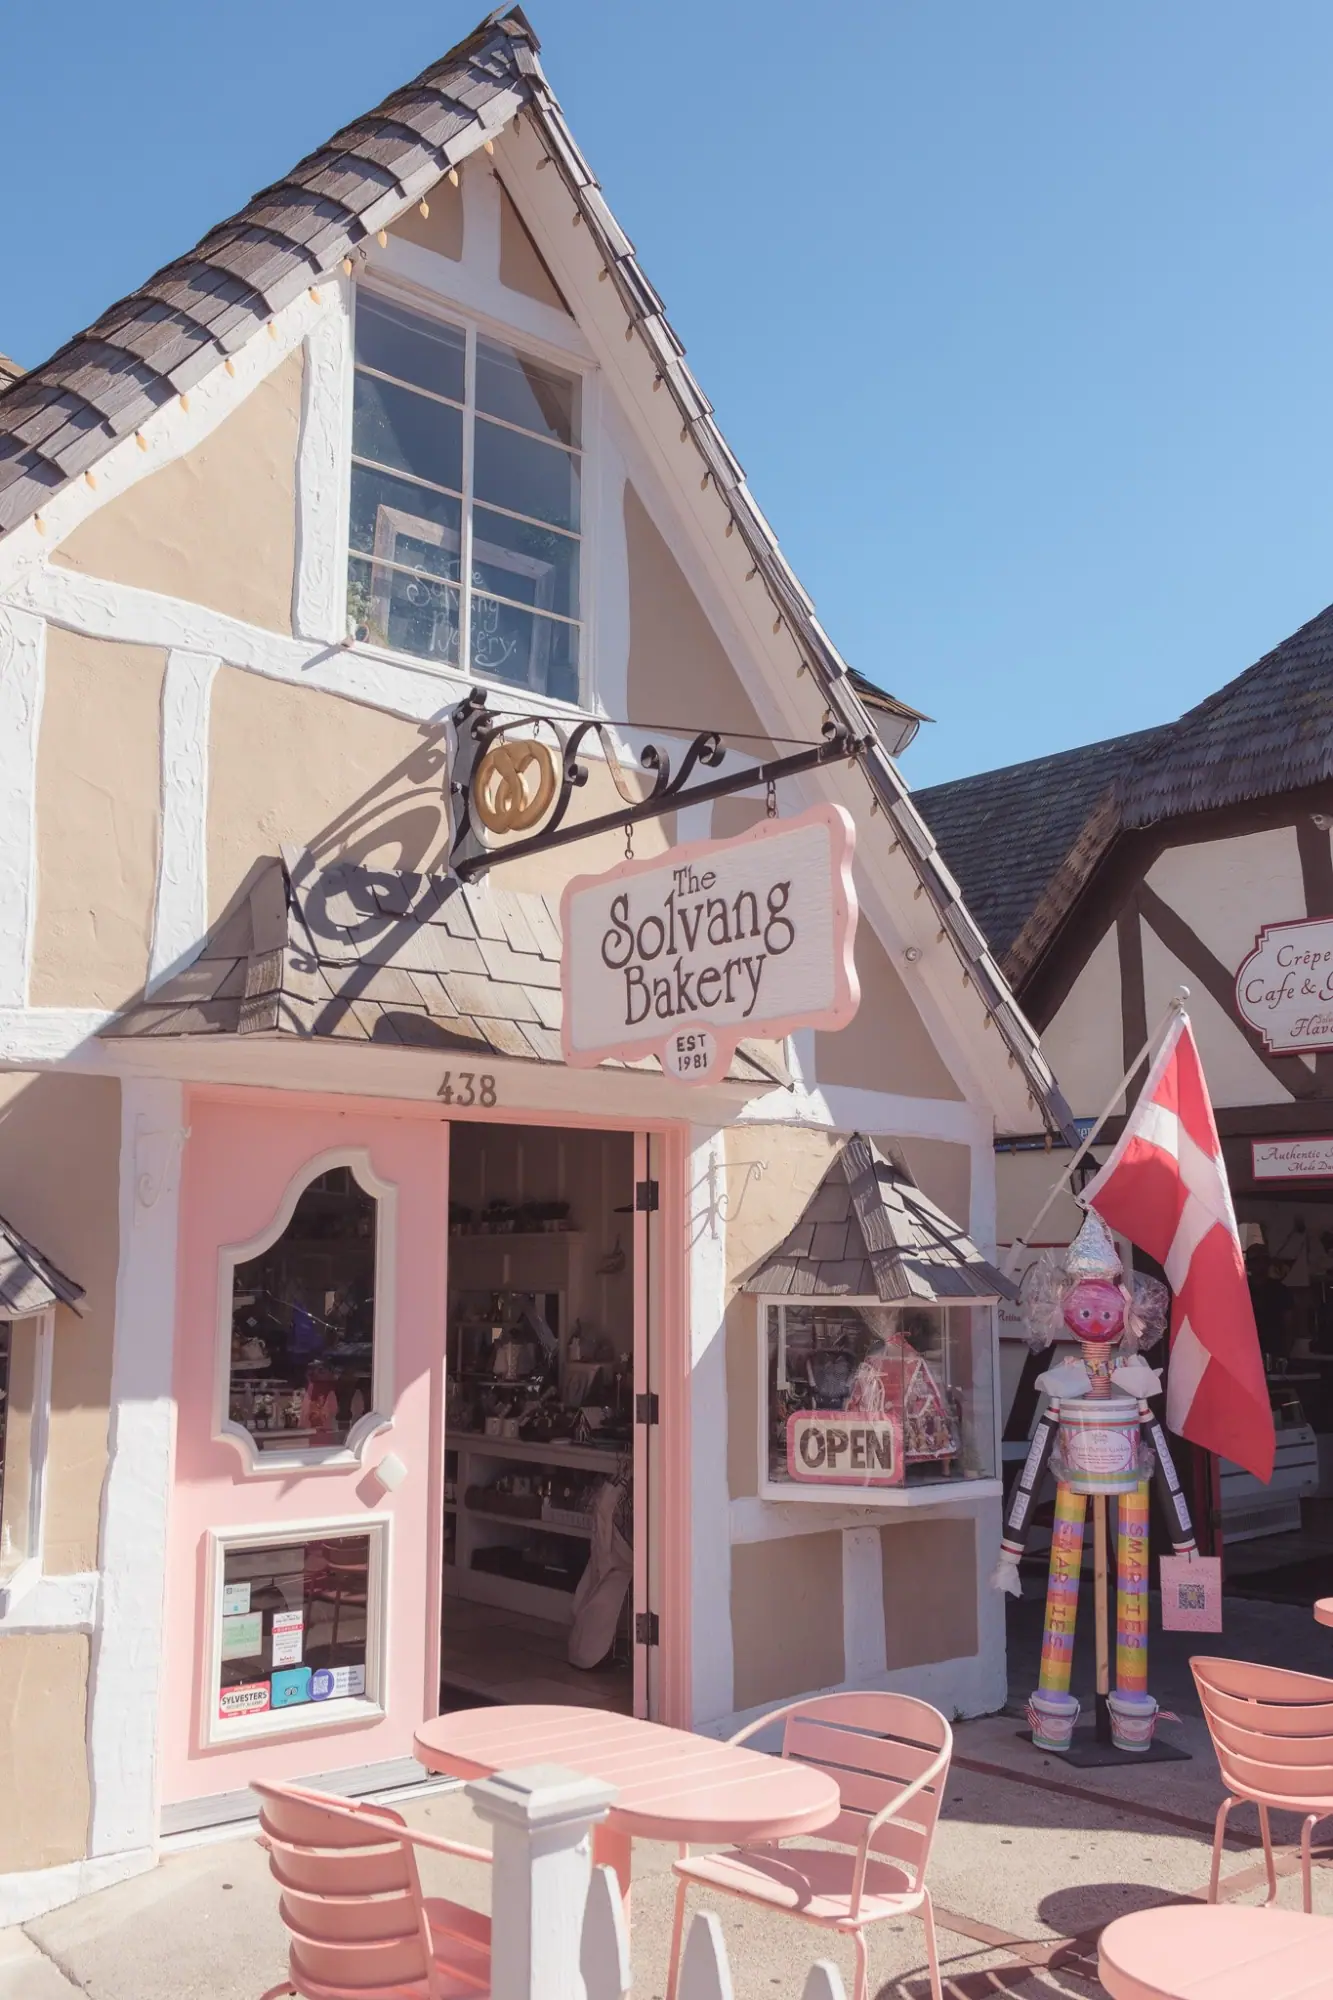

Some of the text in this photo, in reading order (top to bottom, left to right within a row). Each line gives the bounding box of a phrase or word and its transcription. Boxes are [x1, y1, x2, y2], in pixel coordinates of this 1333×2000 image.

[447, 559, 484, 585] Te
[673, 865, 716, 897] The
[601, 880, 795, 970] Solvang
[624, 953, 766, 1026] Bakery
[1245, 971, 1296, 1009] Cafe
[1301, 978, 1317, 995] &
[676, 1033, 707, 1052] EST
[677, 1052, 708, 1071] 1981
[437, 1071, 497, 1108] 438
[1261, 1144, 1321, 1160] Authentic
[799, 1427, 892, 1470] OPEN
[1049, 1521, 1073, 1648] SMARTIES
[1124, 1523, 1143, 1649] SMARTIES
[222, 1691, 267, 1705] SYLVESTERS
